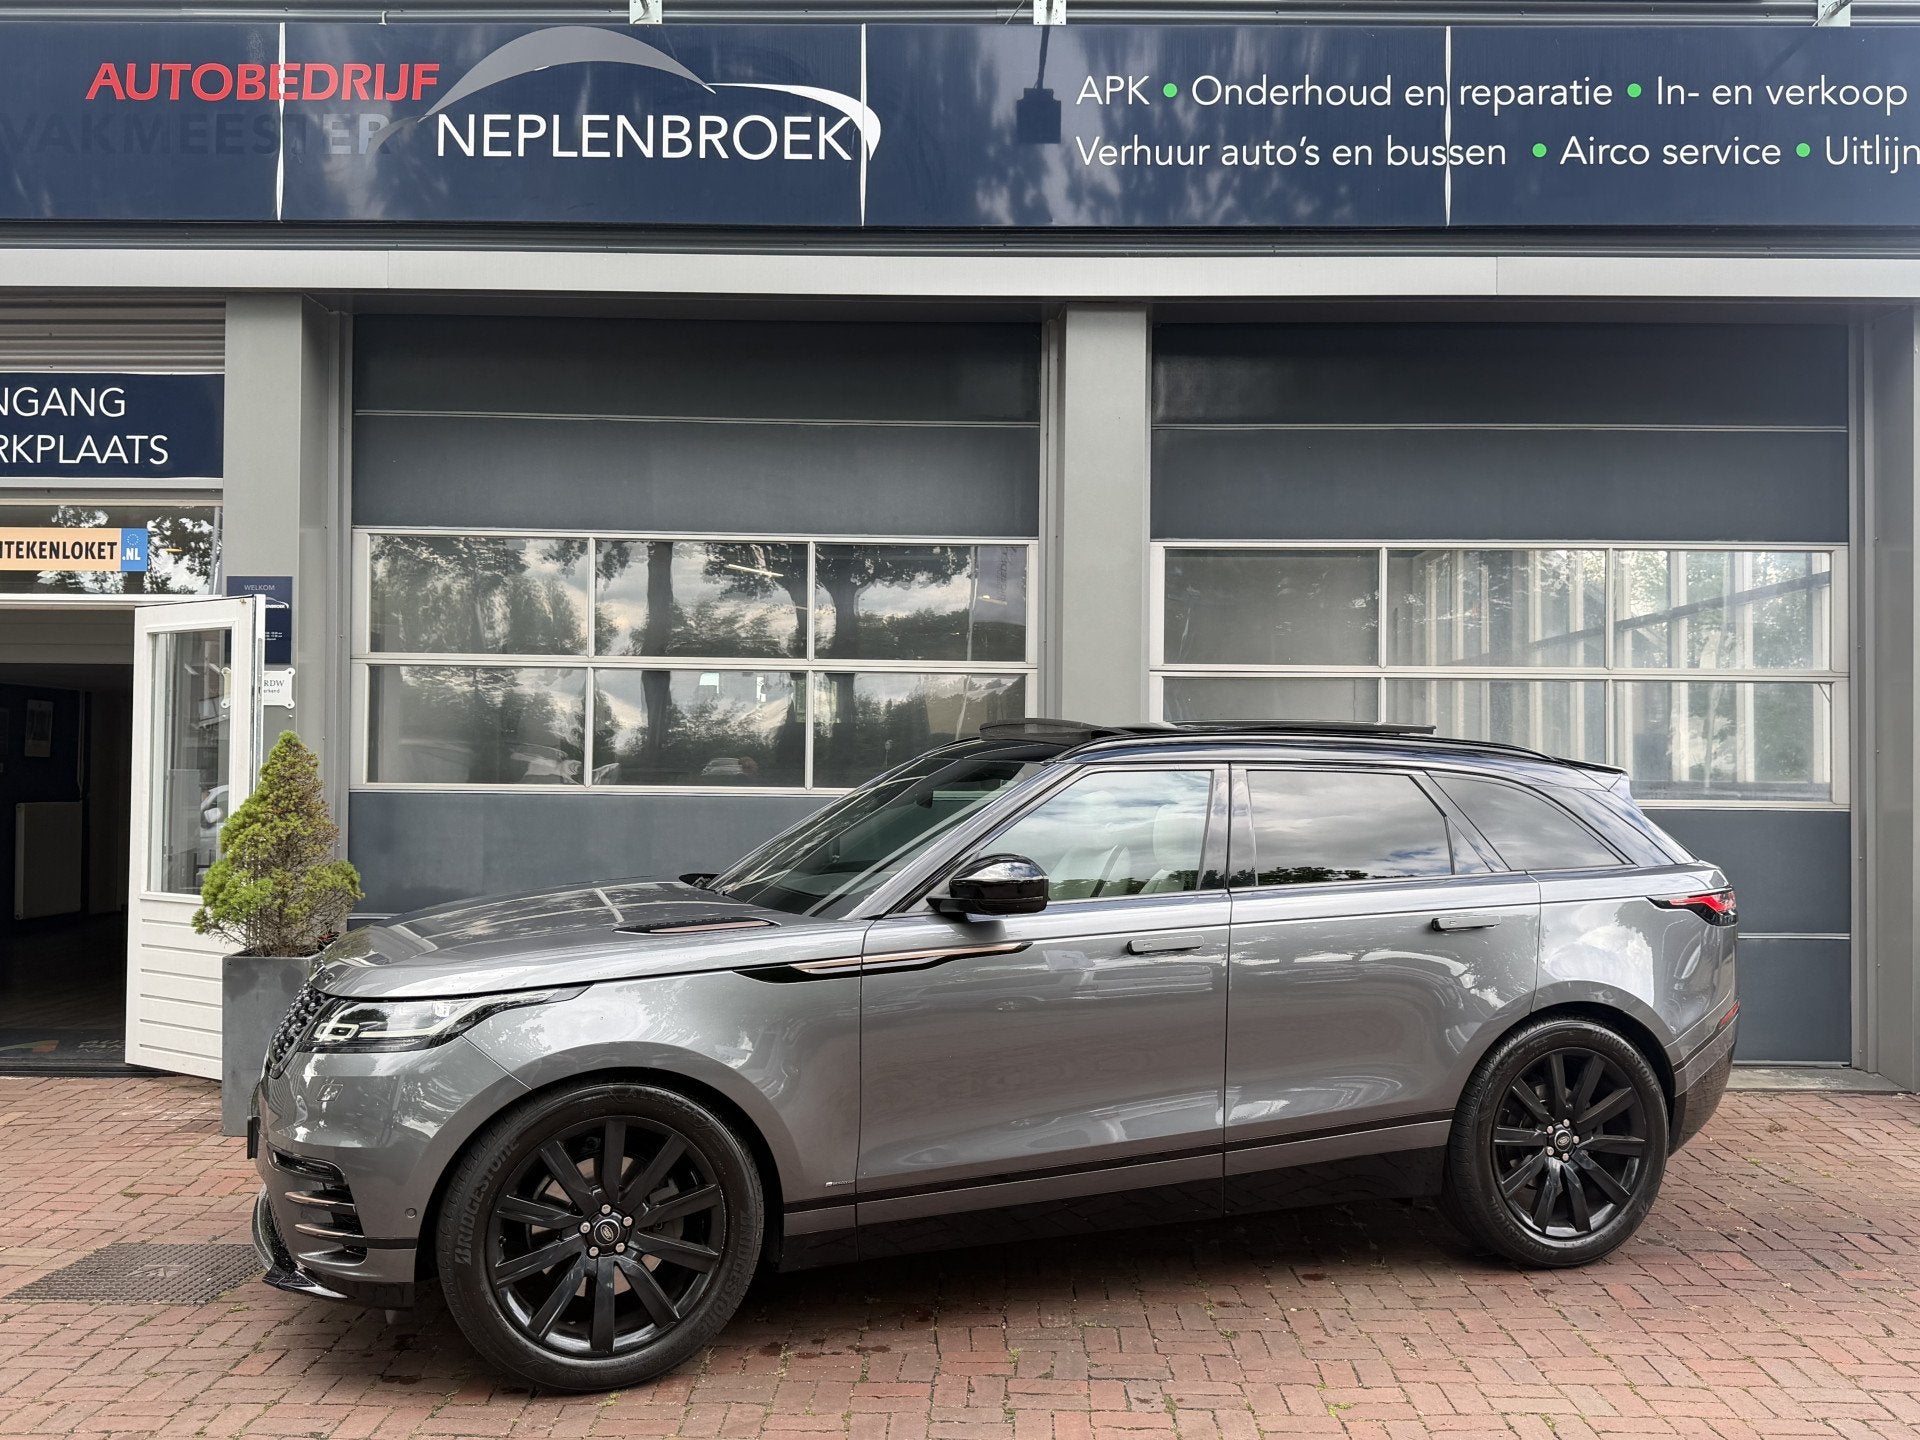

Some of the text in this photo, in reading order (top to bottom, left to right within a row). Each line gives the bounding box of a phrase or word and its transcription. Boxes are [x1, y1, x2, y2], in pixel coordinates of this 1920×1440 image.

[86, 63, 440, 101] AUTOBEDRIJF
[1076, 74, 1908, 117] APK Onderhoud en reparatie In- en verkoop
[1, 112, 392, 155] VAKMEESTER
[437, 113, 852, 161] NEPLENBROEK
[1076, 134, 1211, 166] Verhuur
[1332, 145, 1372, 166] en
[1387, 134, 1506, 166] bussen
[1560, 135, 1650, 165] Airco
[1662, 136, 1782, 165] service
[0, 540, 118, 560] TEKENLOKET
[263, 679, 285, 687] RDW
